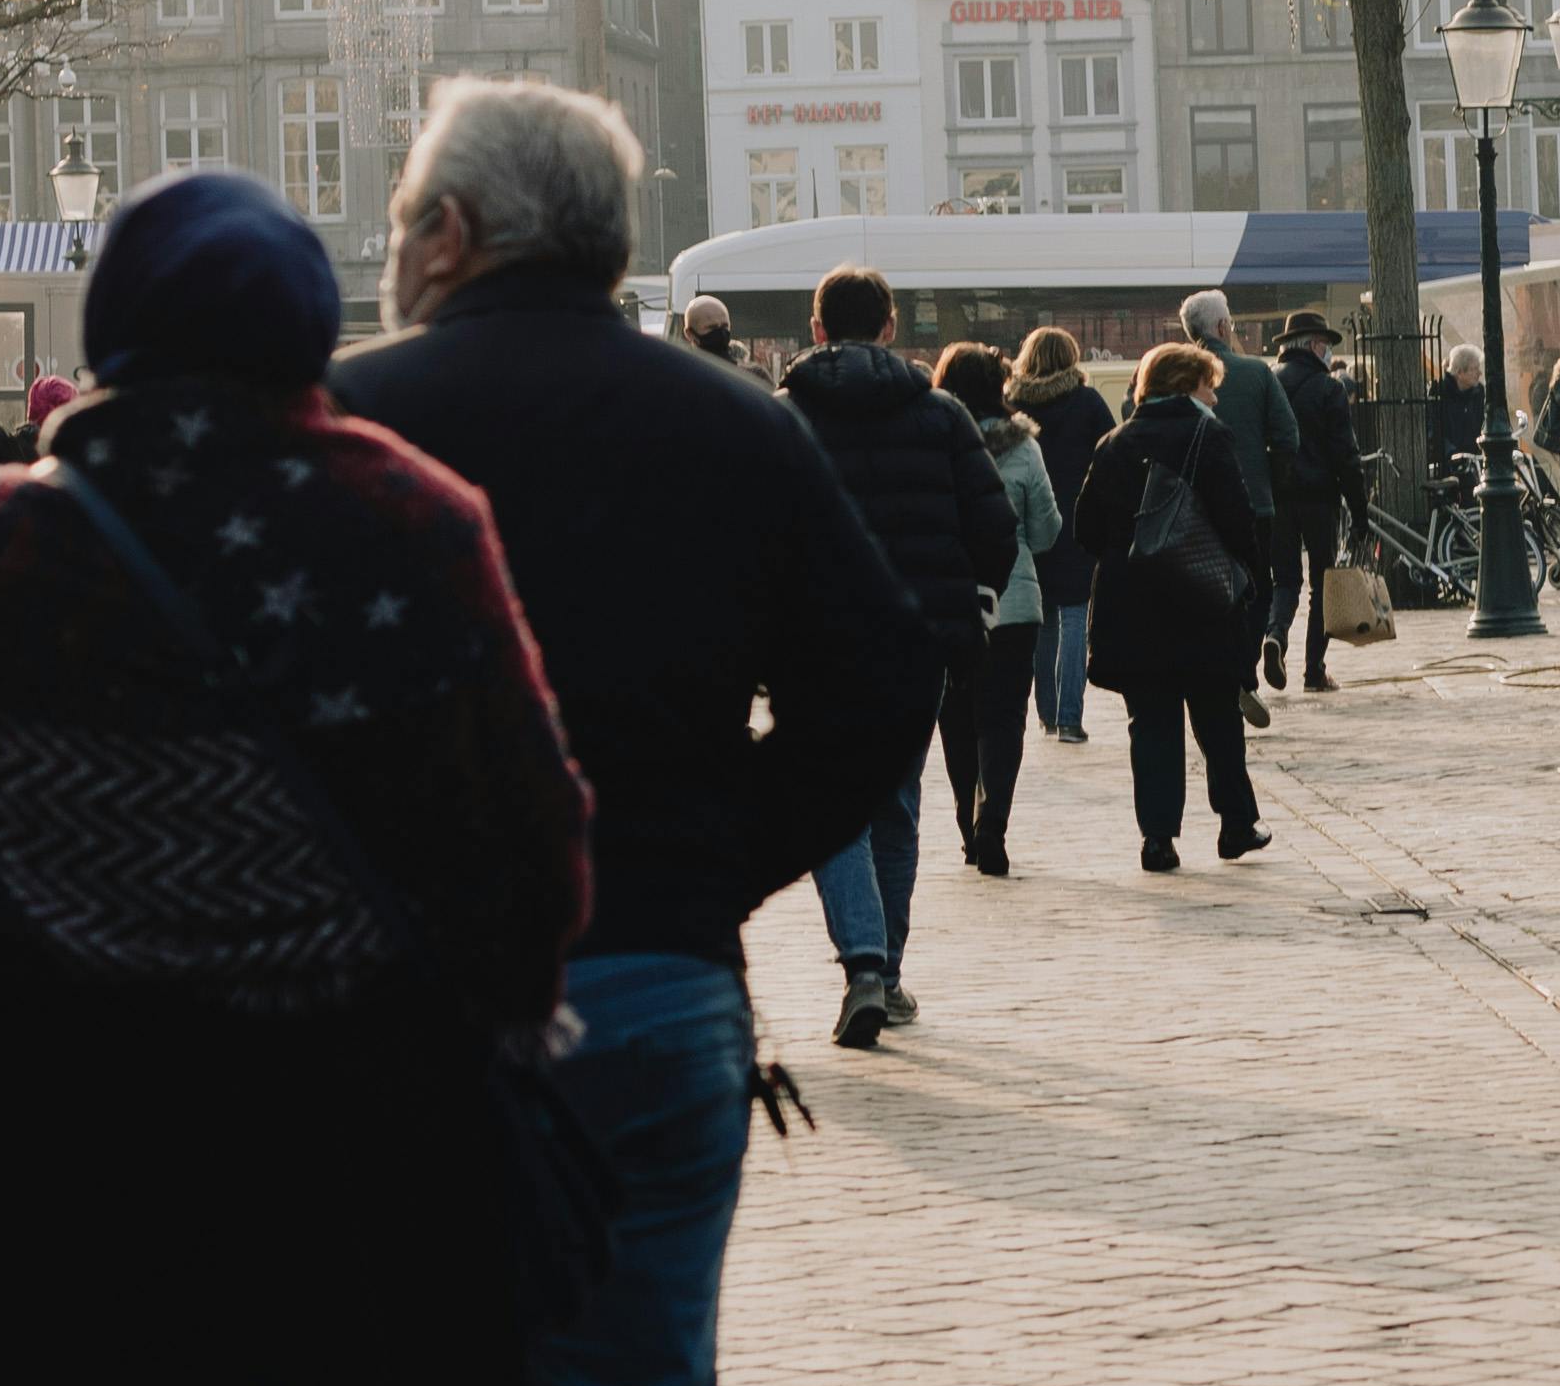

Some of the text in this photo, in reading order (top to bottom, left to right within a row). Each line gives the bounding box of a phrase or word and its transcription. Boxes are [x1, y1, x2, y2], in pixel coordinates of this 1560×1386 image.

[950, 0, 1066, 24] GULPENER
[747, 101, 882, 125] HET HAANTJE
